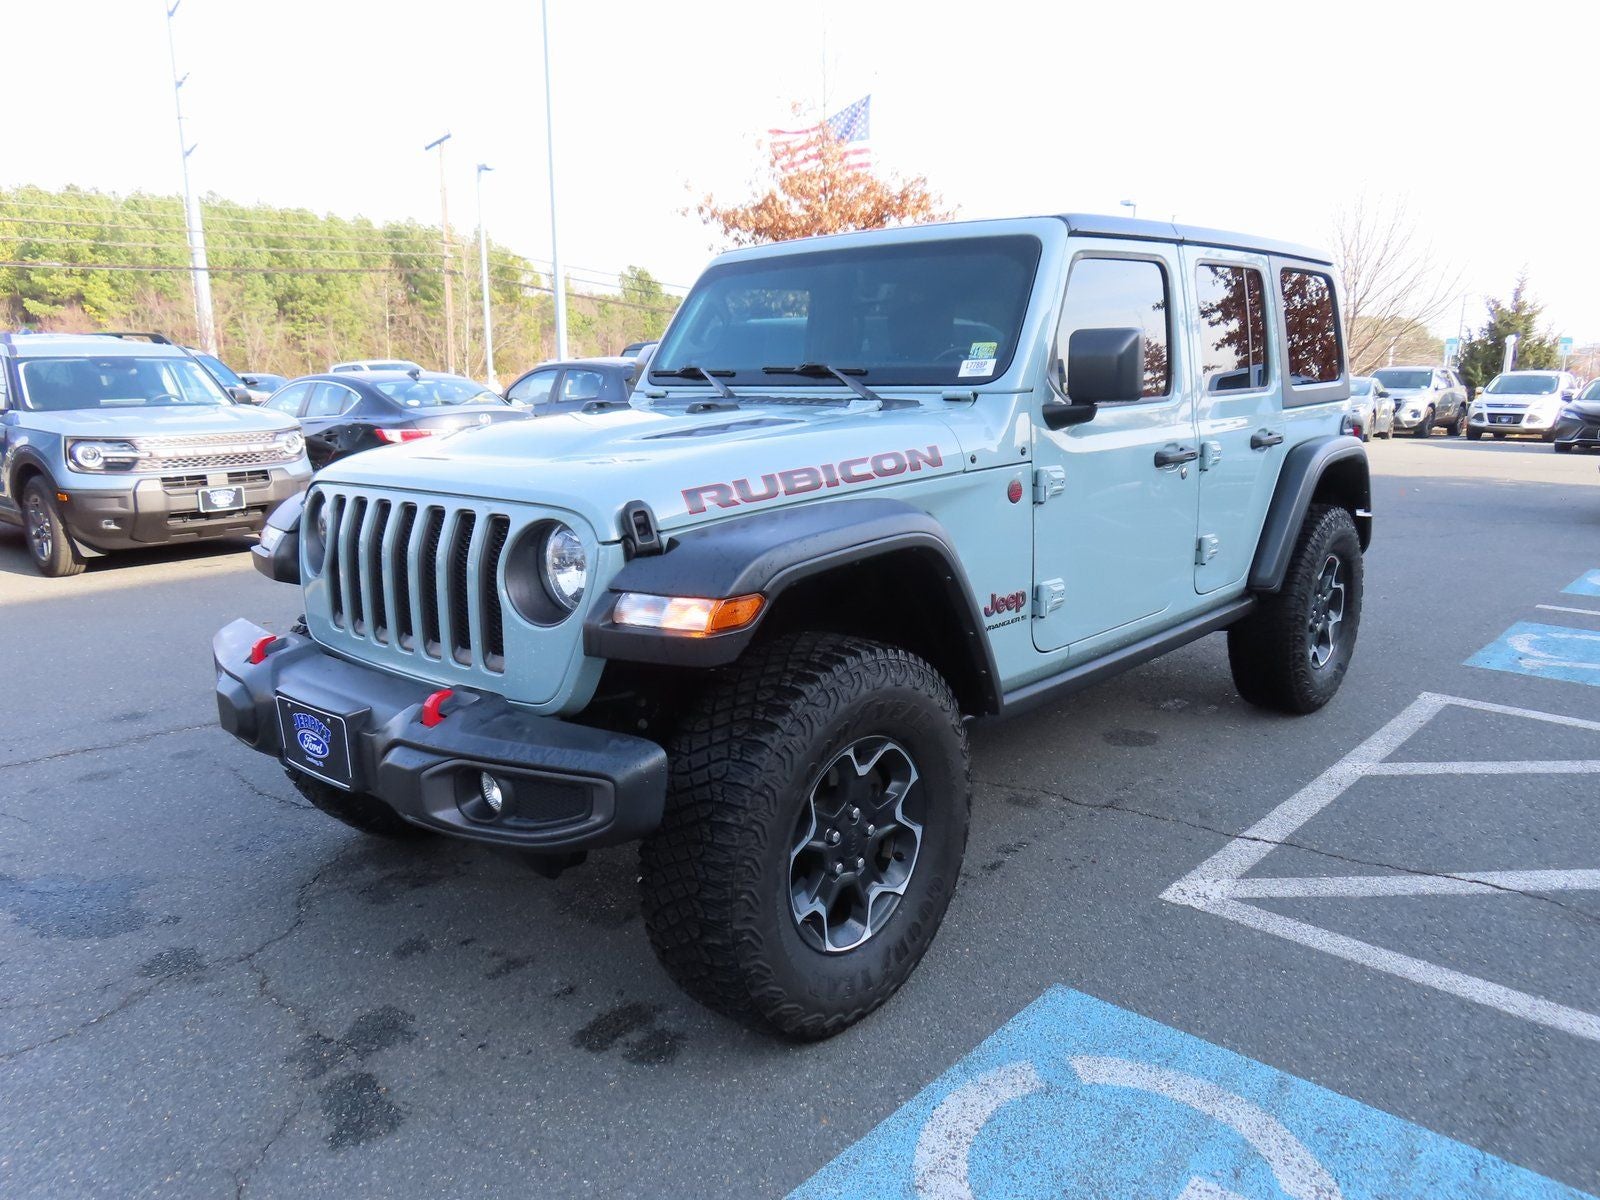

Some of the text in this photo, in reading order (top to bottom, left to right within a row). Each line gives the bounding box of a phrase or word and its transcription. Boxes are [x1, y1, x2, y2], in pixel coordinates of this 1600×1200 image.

[681, 445, 943, 515] RUBICON
[984, 590, 1026, 617] Jeep
[303, 734, 323, 754] Ford
